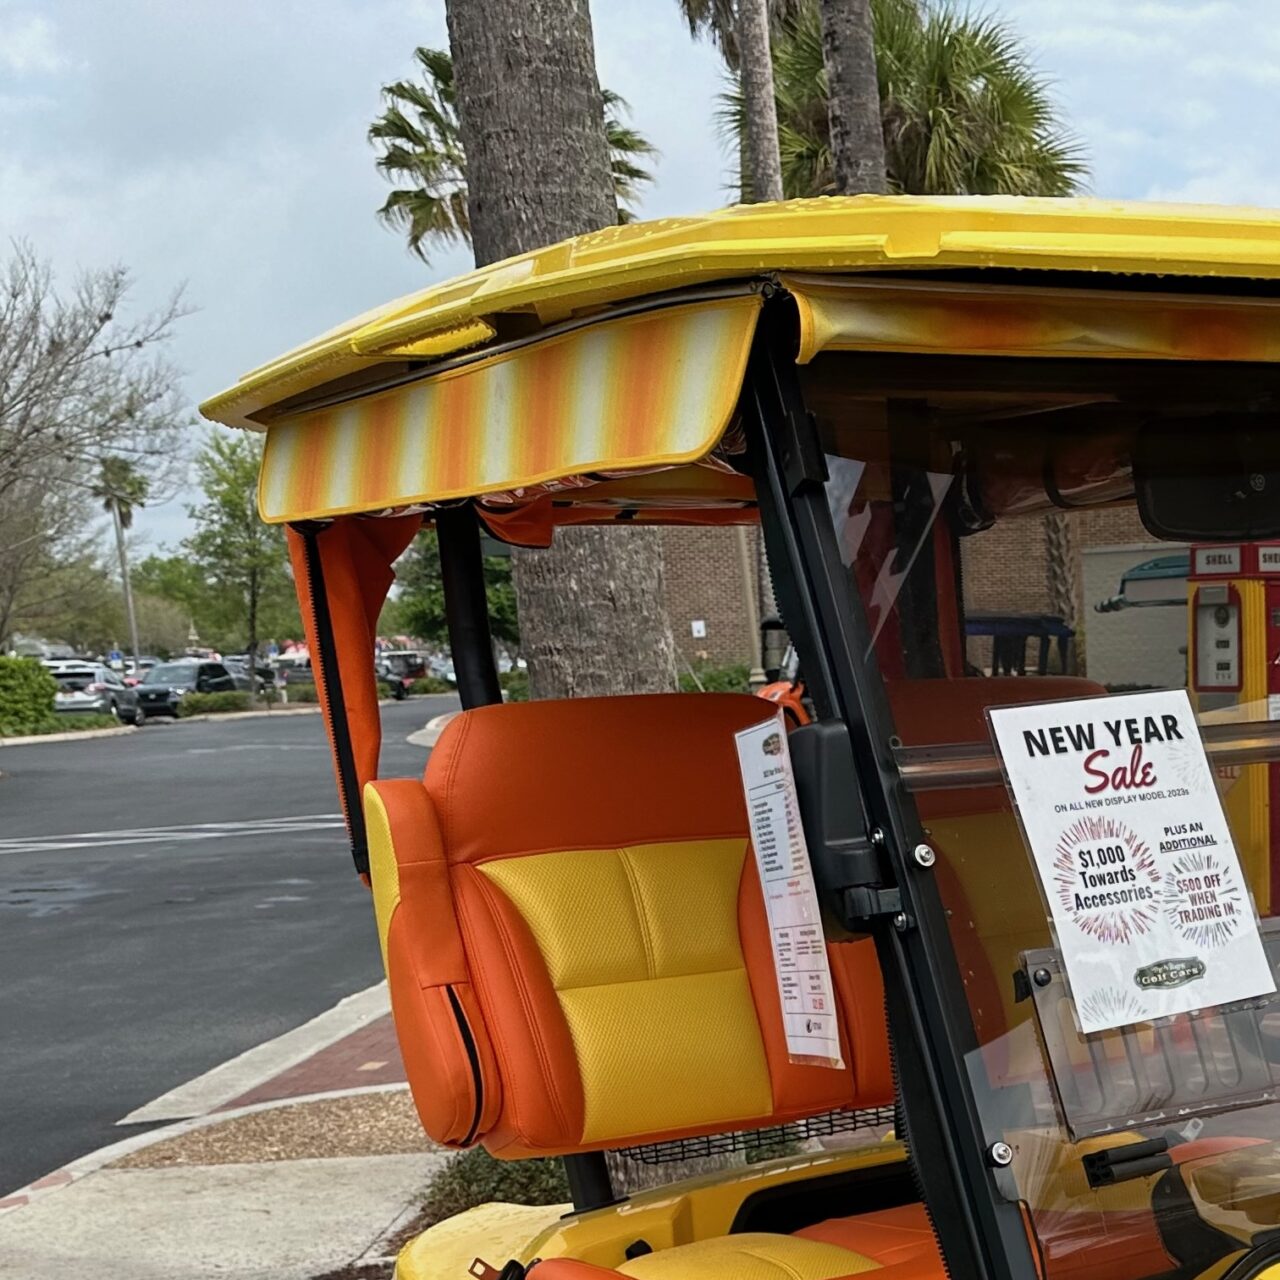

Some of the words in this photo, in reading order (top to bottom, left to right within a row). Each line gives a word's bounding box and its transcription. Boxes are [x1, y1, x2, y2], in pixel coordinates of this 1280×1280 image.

[1205, 553, 1233, 565] SHELL
[1022, 722, 1096, 757] NEW
[1103, 714, 1184, 747] YEAR
[1083, 743, 1157, 794] Sale
[1054, 804, 1068, 813] ON
[1069, 802, 1084, 811] ALL
[1085, 799, 1104, 809] NEW
[1105, 795, 1138, 806] DISPLAY
[1138, 791, 1167, 801] MODEL
[1163, 825, 1188, 836] PLUS
[1189, 822, 1204, 832] AN
[1159, 834, 1217, 852] ADDITIONAL
[1078, 845, 1126, 869] $1,000
[1079, 865, 1137, 889] Towards
[1176, 877, 1202, 894] $500
[1203, 874, 1221, 889] OFF
[1074, 884, 1154, 911] Accessories
[1188, 890, 1217, 906] WHEN
[1178, 905, 1222, 924] TRADING
[1224, 902, 1235, 916] IN
[1141, 973, 1168, 985] Golf
[1169, 967, 1199, 979] Cars
